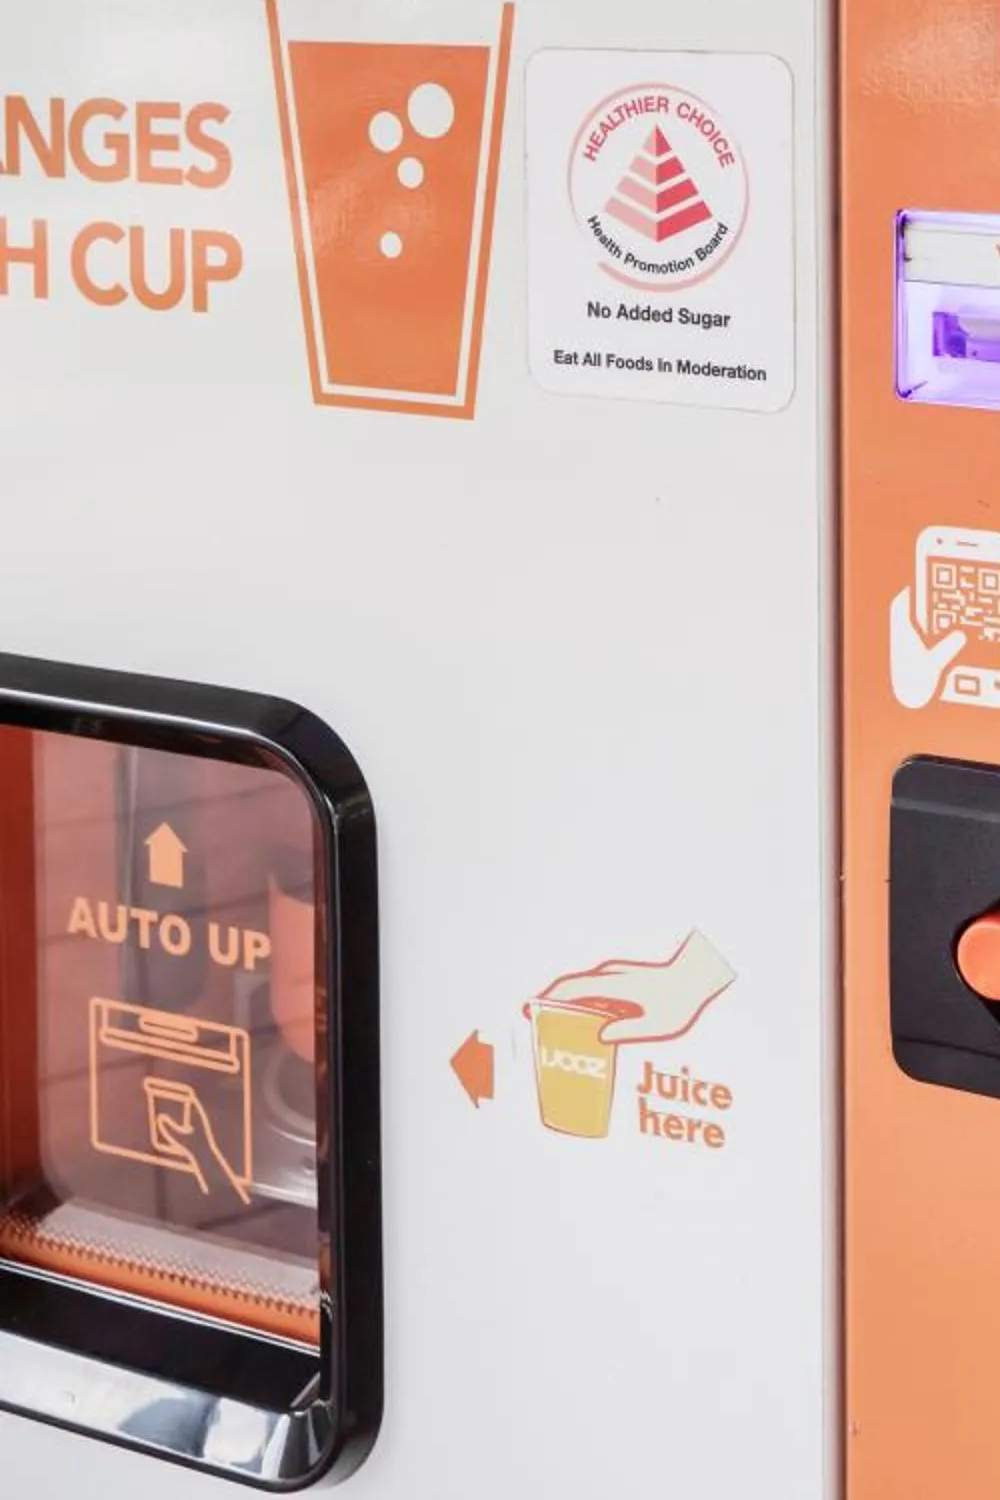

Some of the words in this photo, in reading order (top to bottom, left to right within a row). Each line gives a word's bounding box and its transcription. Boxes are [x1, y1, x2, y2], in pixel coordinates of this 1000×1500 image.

[0, 95, 232, 189] NGES
[583, 96, 669, 161] HEALTHIER
[676, 102, 735, 168] CHOICE
[71, 221, 244, 313] CUP
[587, 215, 622, 258] Health
[624, 252, 695, 275] Promotion
[695, 222, 729, 262] Board
[587, 301, 611, 319] No
[616, 303, 673, 324] Added
[678, 308, 731, 330] Sugar
[553, 349, 579, 366] Eat
[582, 352, 602, 367] All
[606, 353, 653, 373] Foods
[657, 358, 673, 374] In
[677, 359, 768, 382] Moderation
[67, 896, 192, 957] AUTO
[209, 922, 272, 971] UP
[637, 1060, 733, 1110] Juice
[638, 1097, 726, 1150] here
